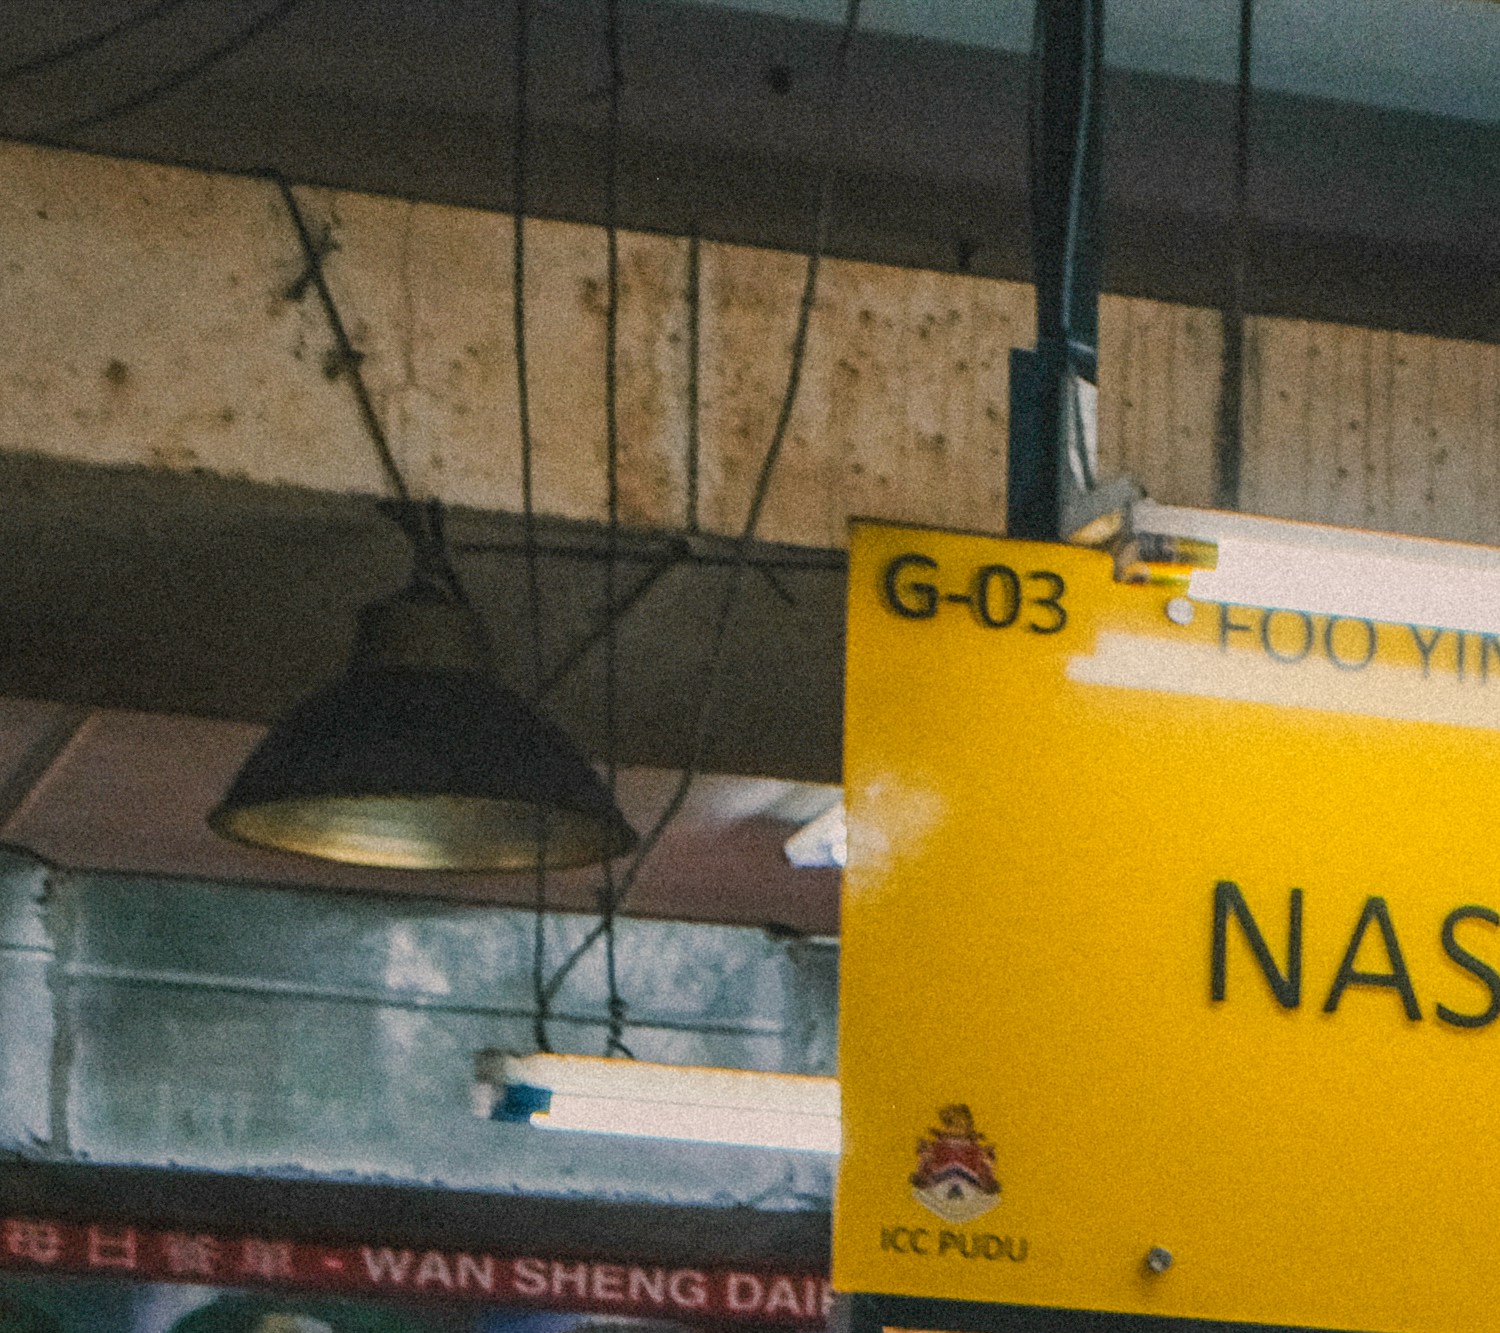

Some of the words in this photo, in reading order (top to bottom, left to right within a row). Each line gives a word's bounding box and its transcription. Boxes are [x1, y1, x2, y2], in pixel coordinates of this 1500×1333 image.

[883, 553, 1068, 635] G-03
[1218, 601, 1376, 671] FOO
[878, 1224, 931, 1259] ICC
[937, 1228, 1030, 1265] PUDU
[361, 1246, 496, 1294] WAN
[513, 1256, 704, 1309] SHENG
[726, 1272, 832, 1320] DAI
